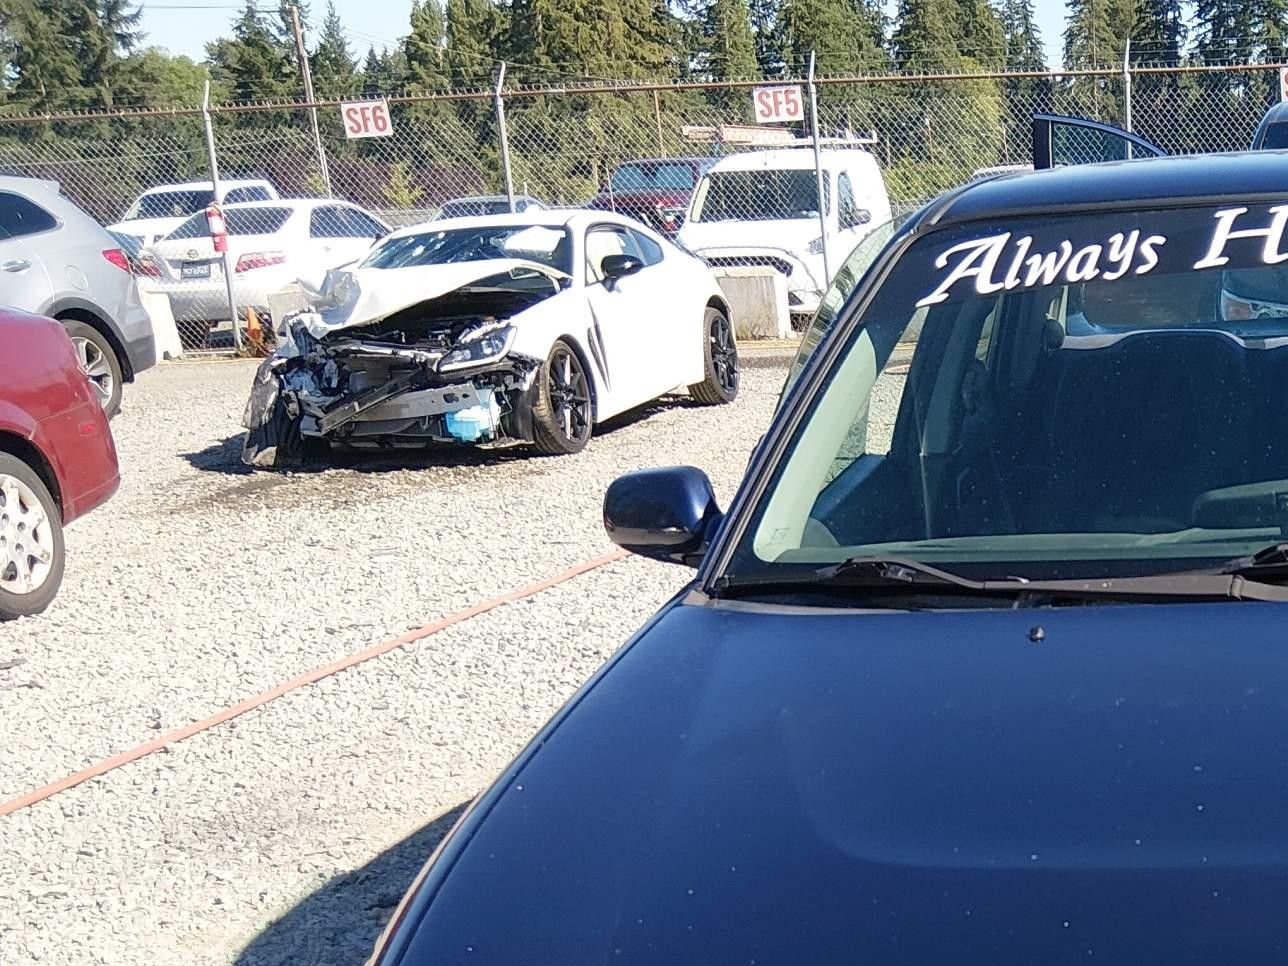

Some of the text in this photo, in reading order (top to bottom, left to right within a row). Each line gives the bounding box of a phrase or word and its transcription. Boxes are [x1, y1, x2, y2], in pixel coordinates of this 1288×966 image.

[757, 89, 799, 118] SF5
[345, 105, 388, 134] SF6
[912, 229, 1167, 308] Always
